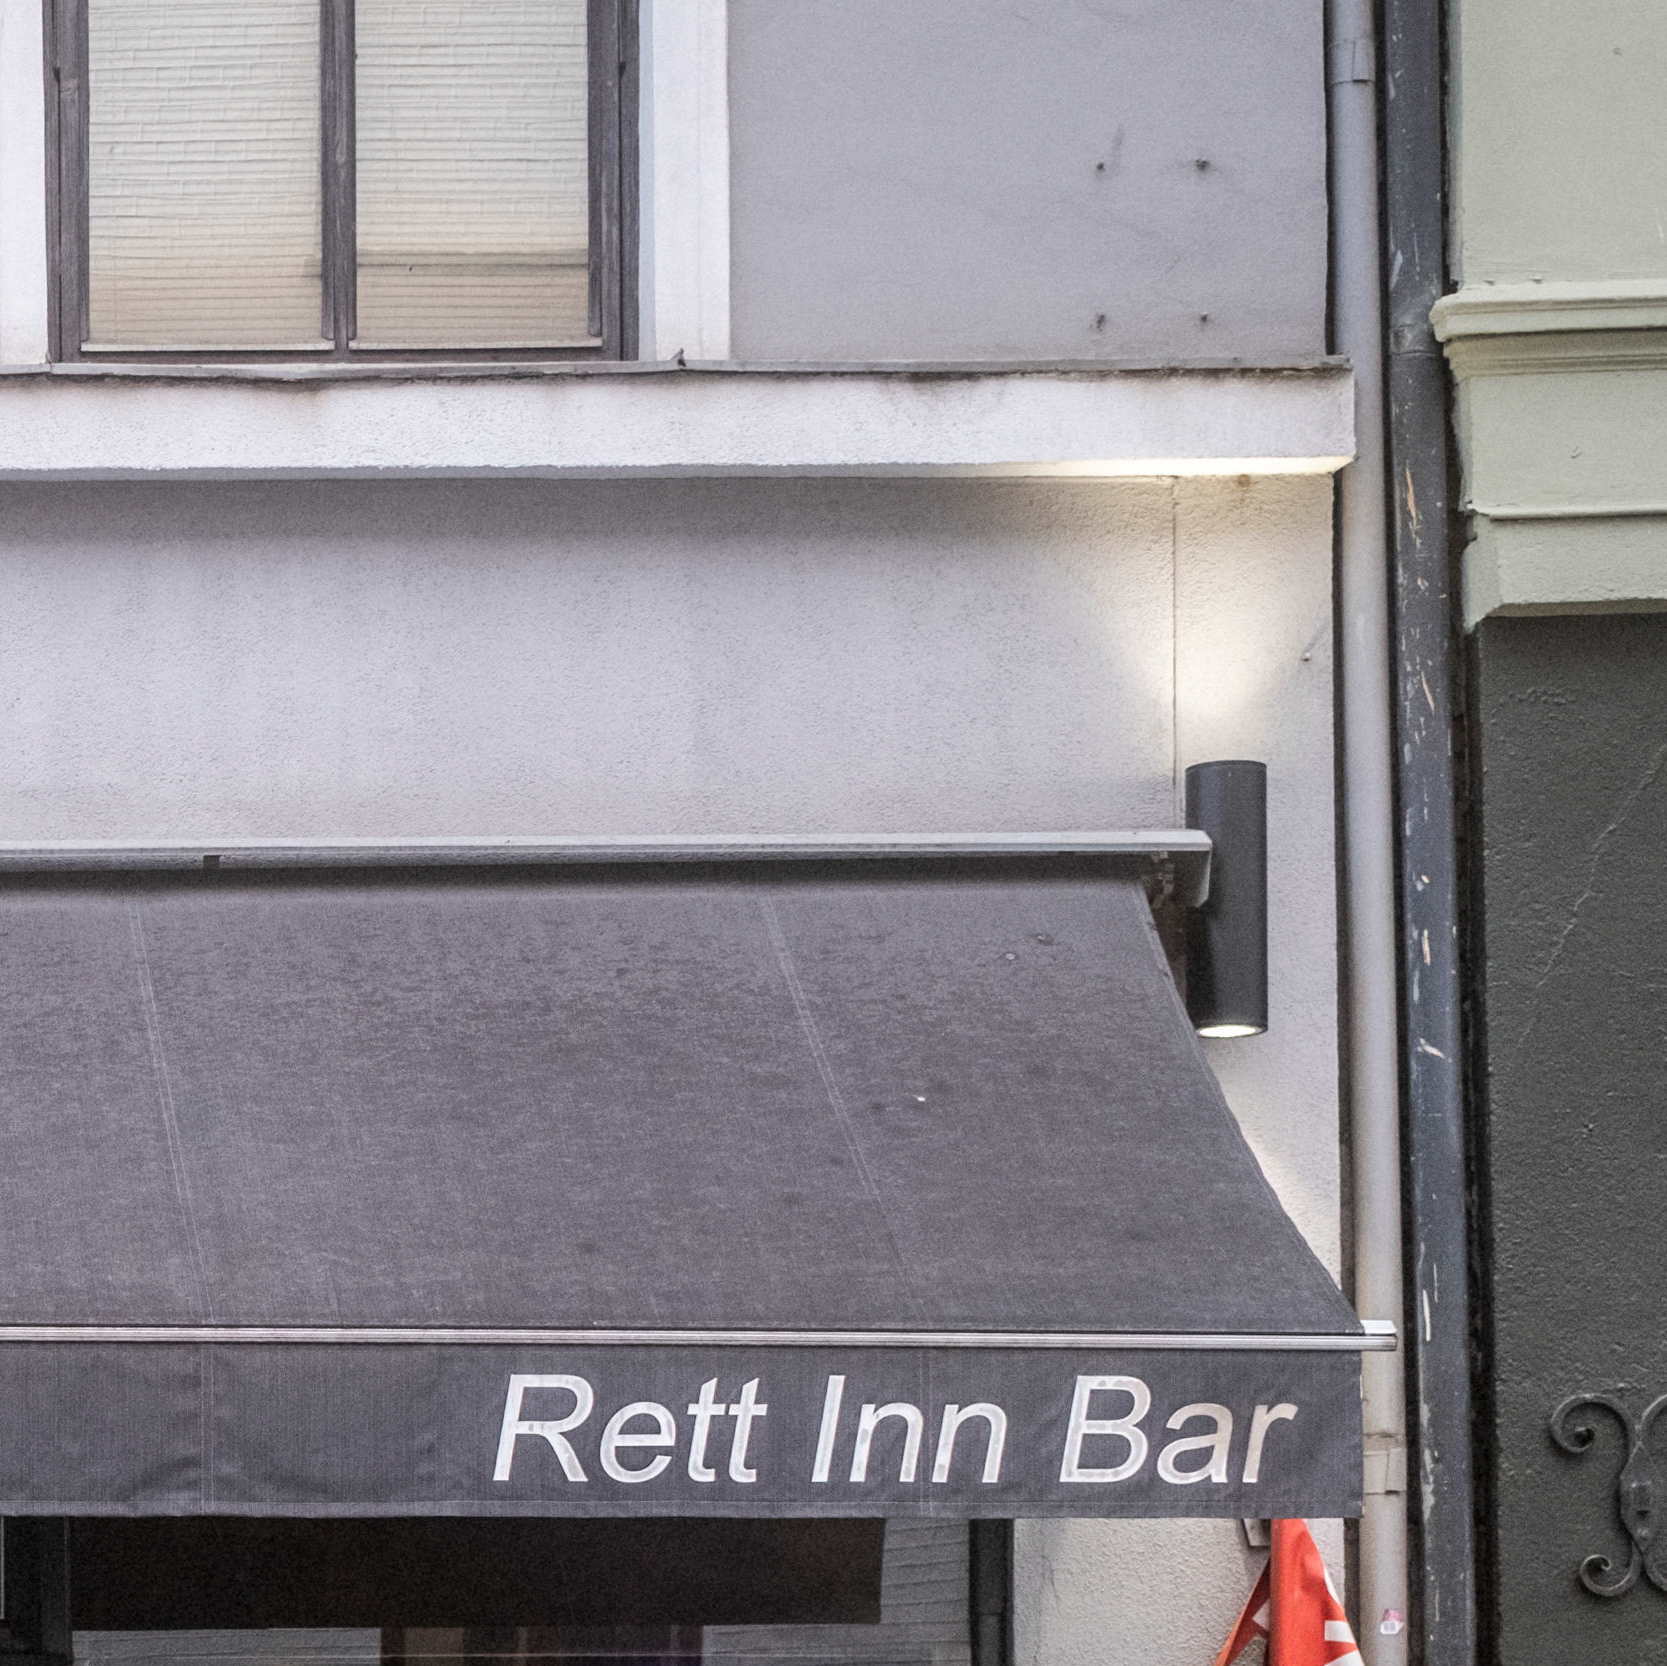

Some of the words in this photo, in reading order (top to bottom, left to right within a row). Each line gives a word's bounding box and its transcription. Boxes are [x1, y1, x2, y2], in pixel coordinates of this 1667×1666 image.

[493, 1374, 768, 1483] Rett
[812, 1375, 1007, 1483] Inn
[1059, 1375, 1298, 1484] Bar
